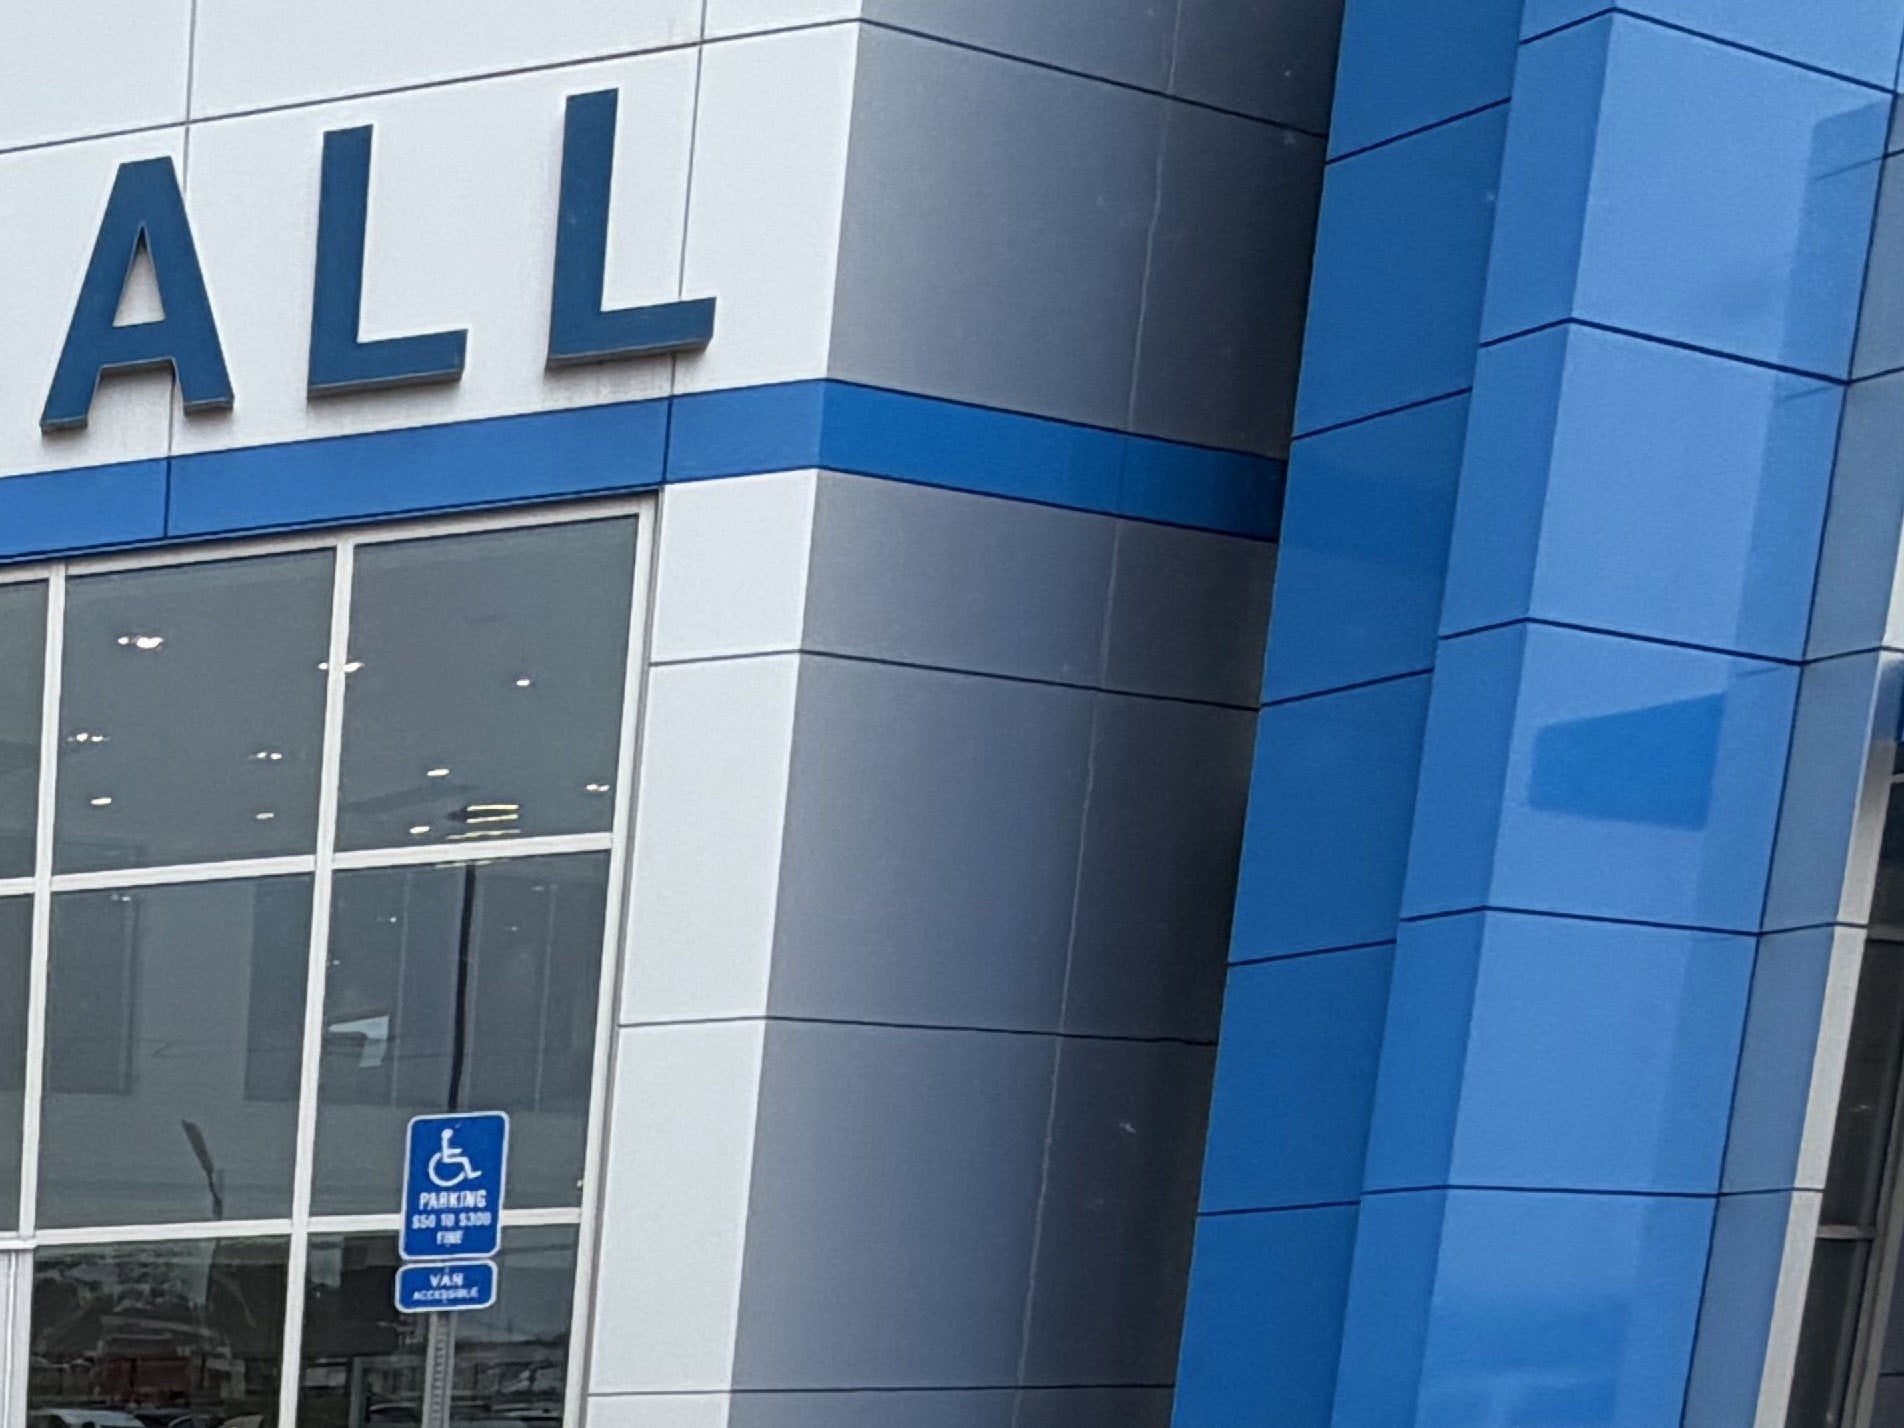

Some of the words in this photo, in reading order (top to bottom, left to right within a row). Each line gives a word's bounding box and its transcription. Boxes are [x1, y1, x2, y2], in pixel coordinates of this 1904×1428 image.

[419, 1189, 487, 1210] PARKING
[412, 1214, 436, 1230] $50
[440, 1213, 456, 1227] TO
[429, 1272, 464, 1288] VAN
